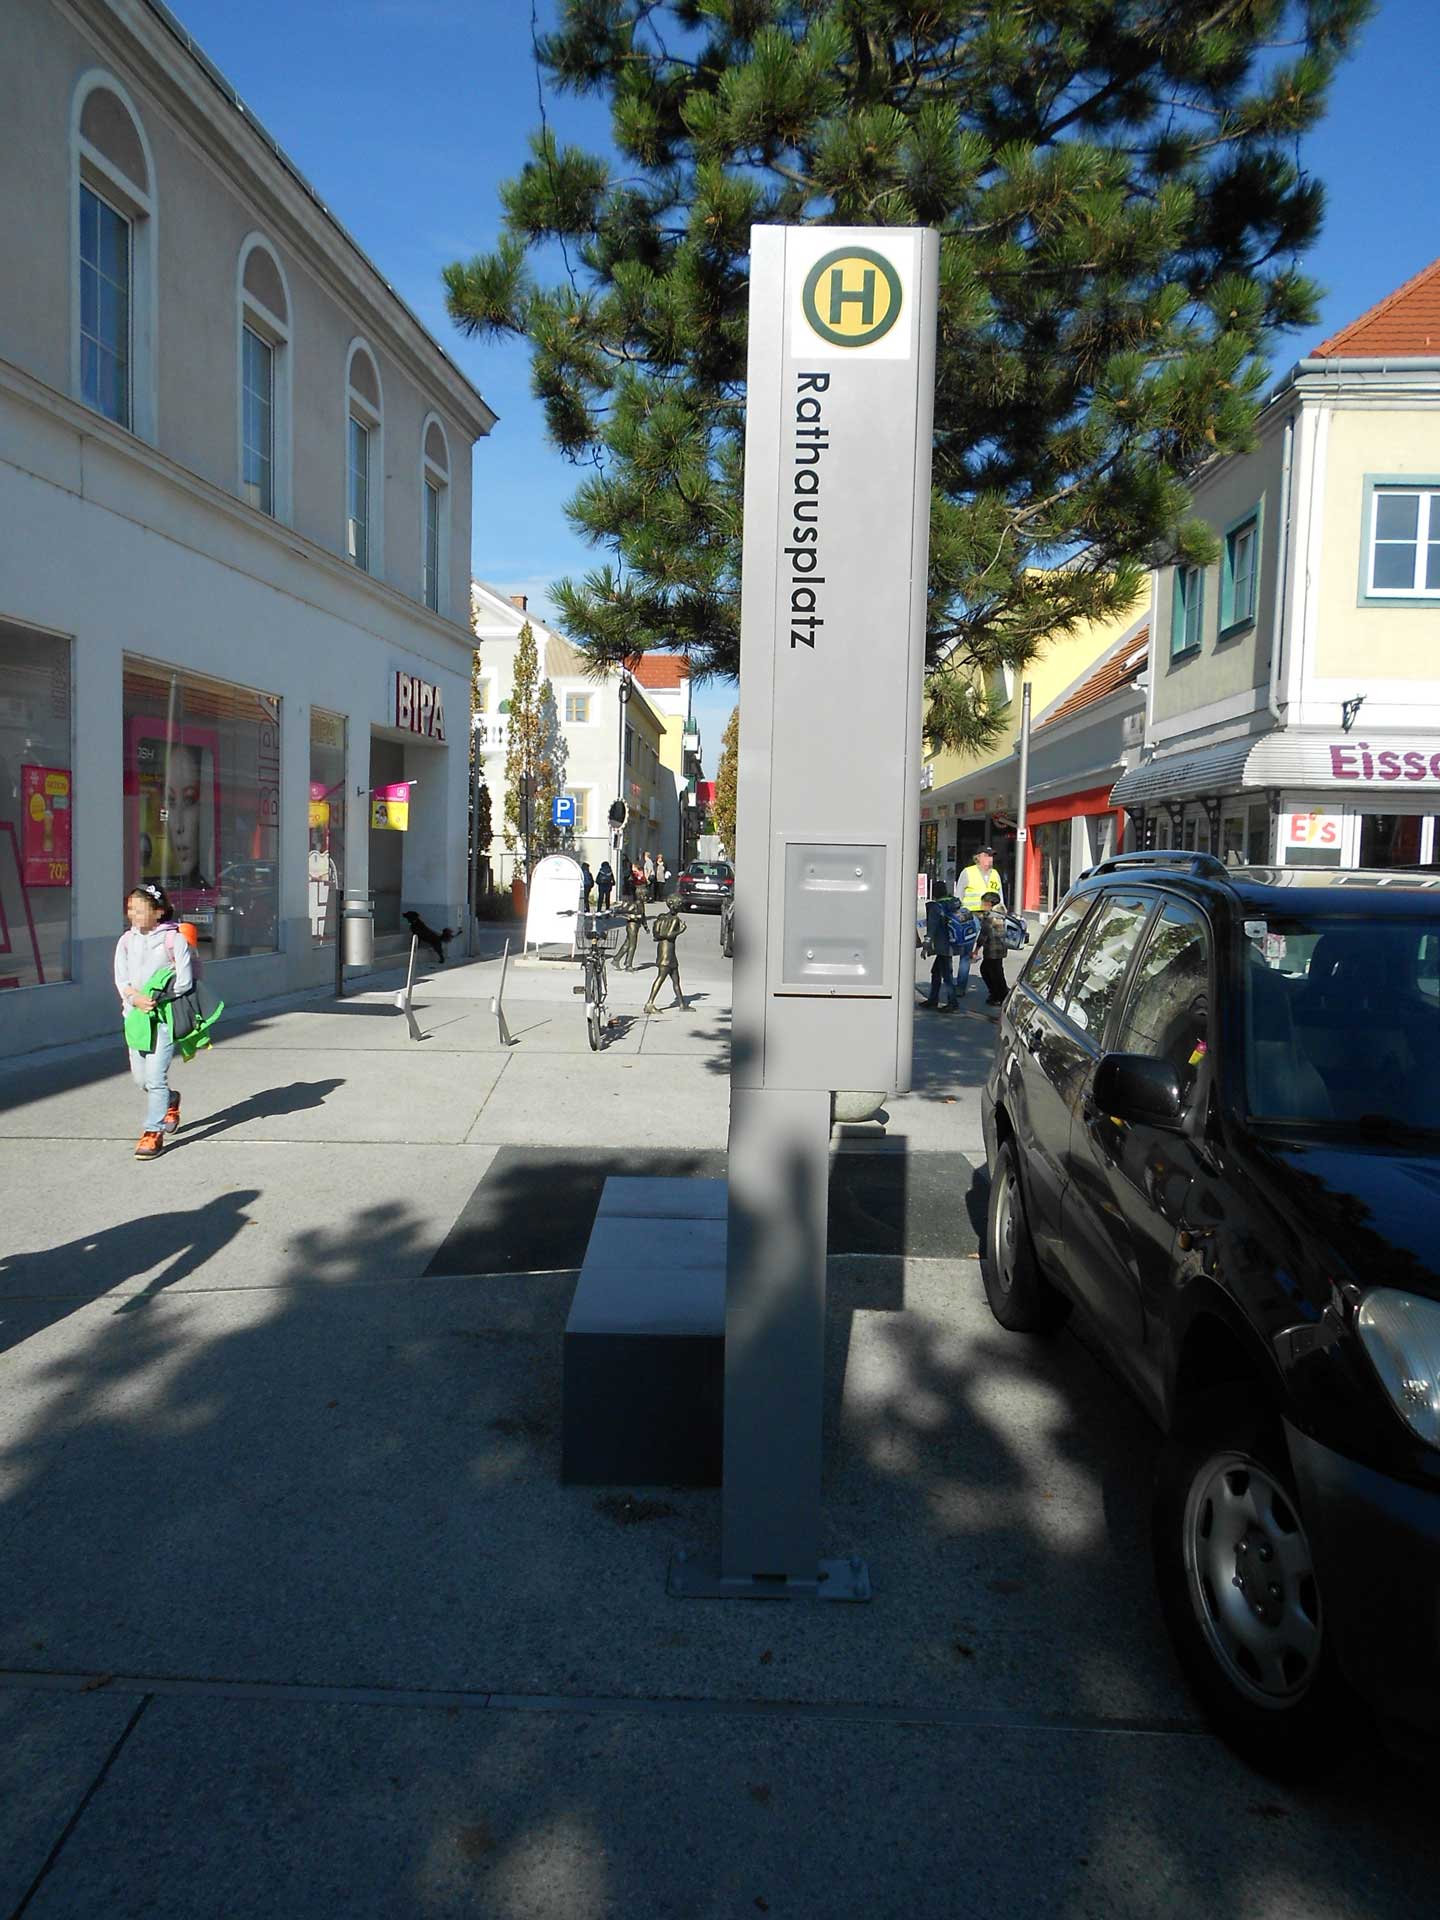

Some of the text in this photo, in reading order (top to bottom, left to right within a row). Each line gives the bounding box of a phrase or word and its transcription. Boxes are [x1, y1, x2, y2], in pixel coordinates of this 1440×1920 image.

[829, 268, 876, 326] H
[784, 372, 830, 649] Rathausplatz
[396, 671, 446, 741] BIPA
[556, 799, 571, 818] P
[1290, 811, 1337, 844] Eis
